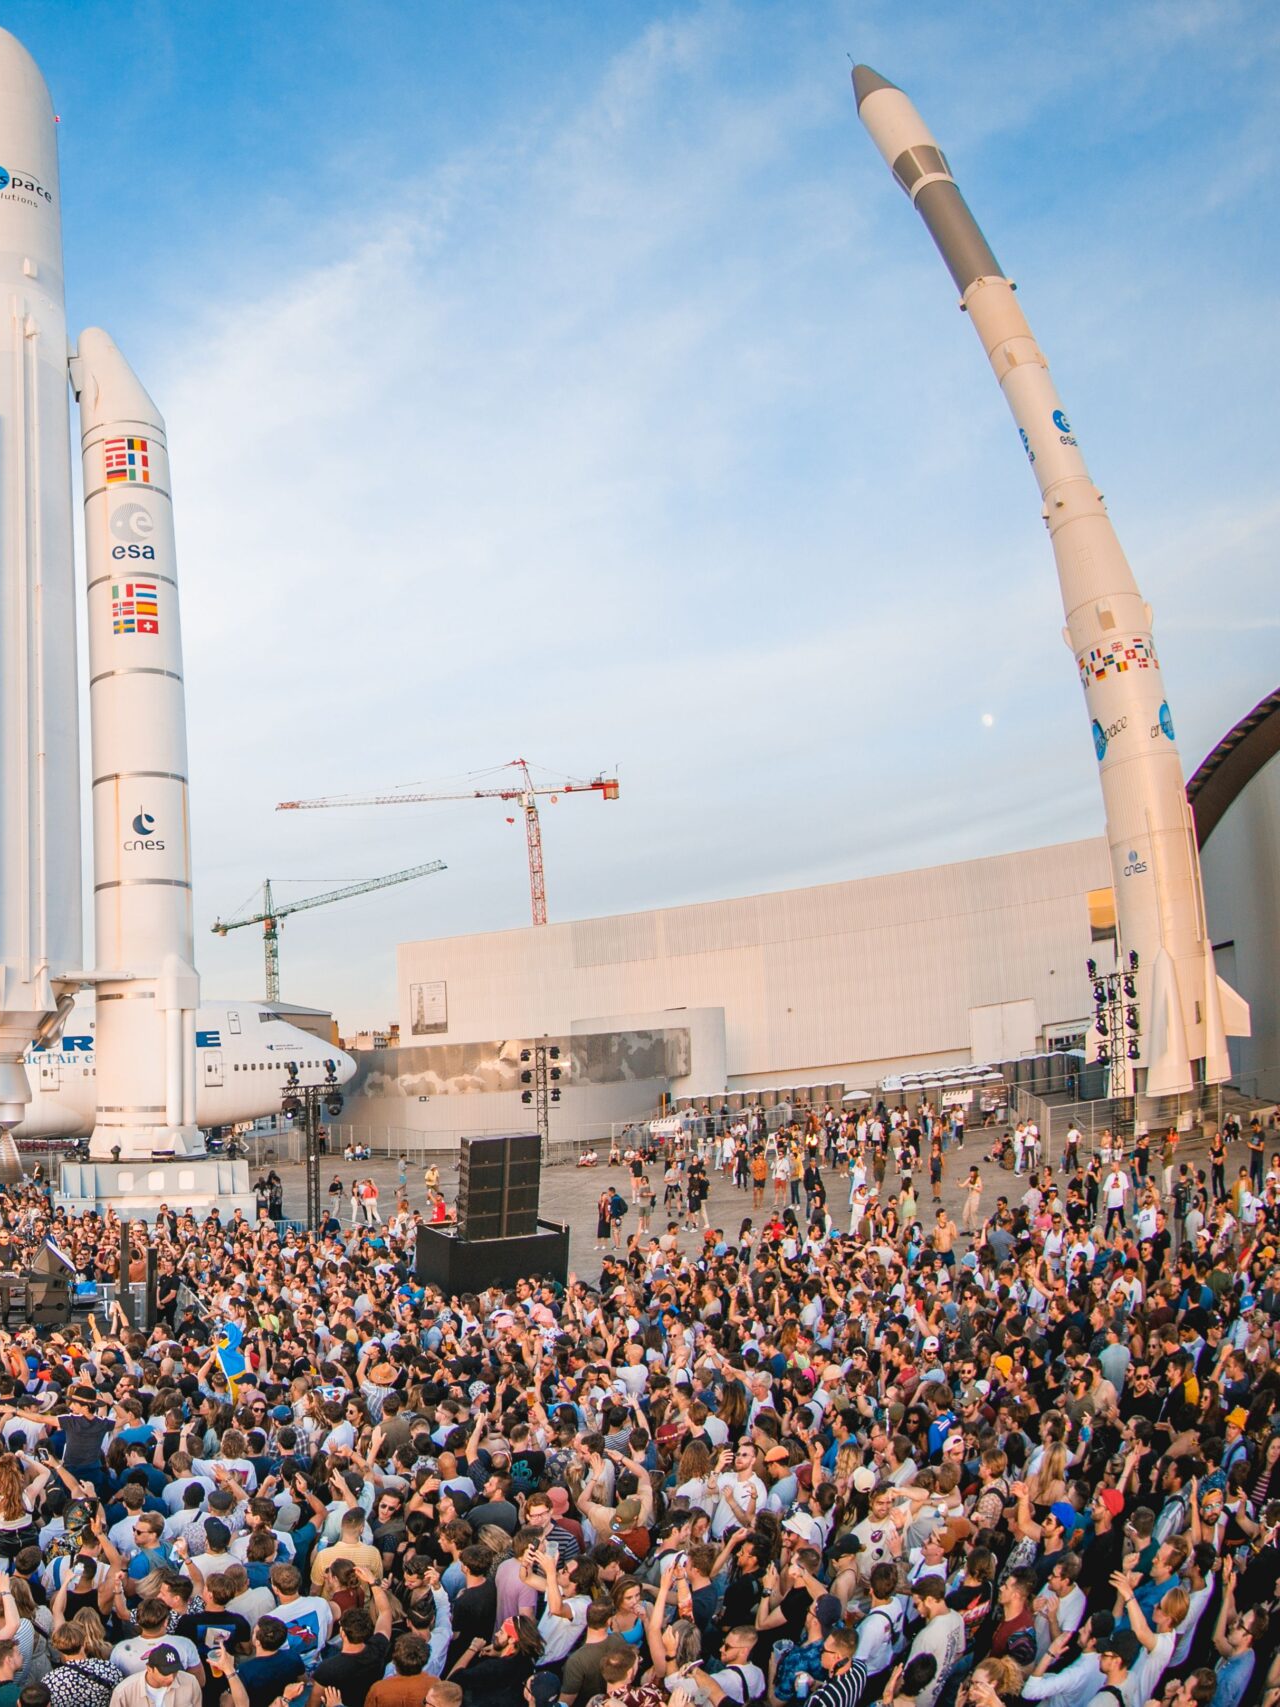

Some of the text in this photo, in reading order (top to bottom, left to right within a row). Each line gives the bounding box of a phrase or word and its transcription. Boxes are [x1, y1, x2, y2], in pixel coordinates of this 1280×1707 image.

[111, 544, 155, 560] esa
[123, 840, 165, 851] cnes
[1123, 861, 1147, 877] cnes
